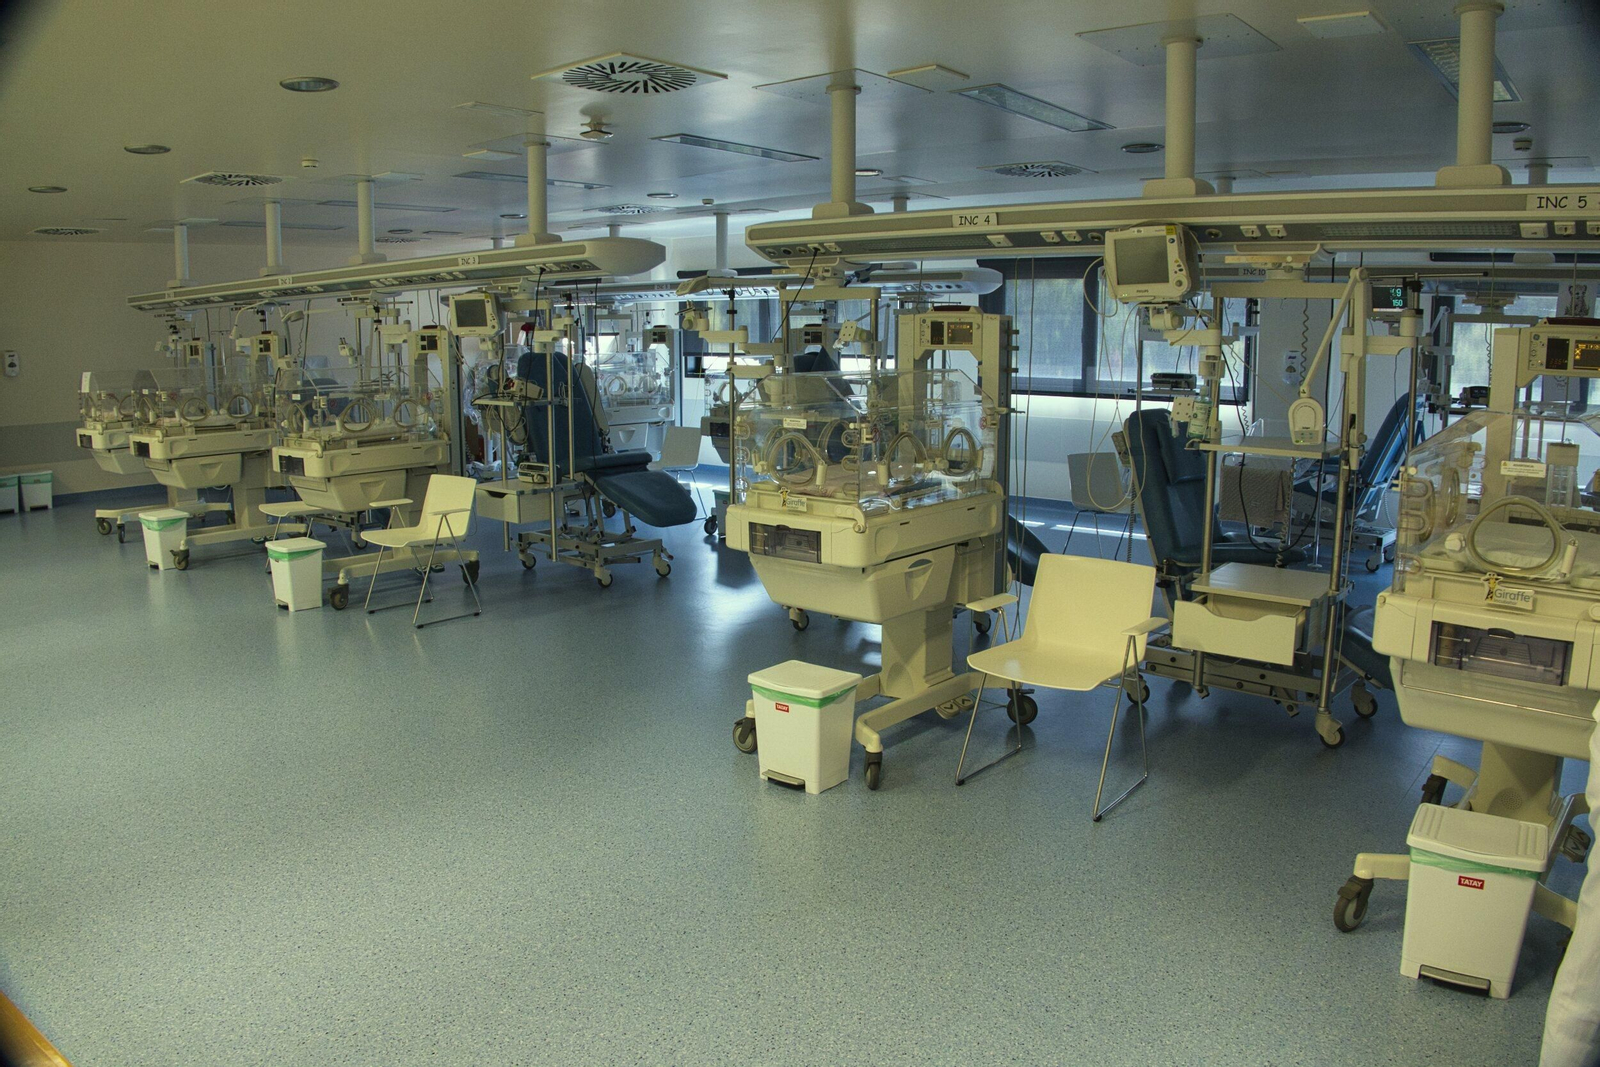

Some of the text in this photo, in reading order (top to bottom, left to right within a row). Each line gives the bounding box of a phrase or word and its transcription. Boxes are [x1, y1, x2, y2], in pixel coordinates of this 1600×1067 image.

[1537, 195, 1588, 209] INC 5
[958, 214, 991, 226] INC 4
[1242, 268, 1257, 276] INC
[1494, 588, 1531, 602] Giraffe
[1460, 877, 1483, 888] TATAY
